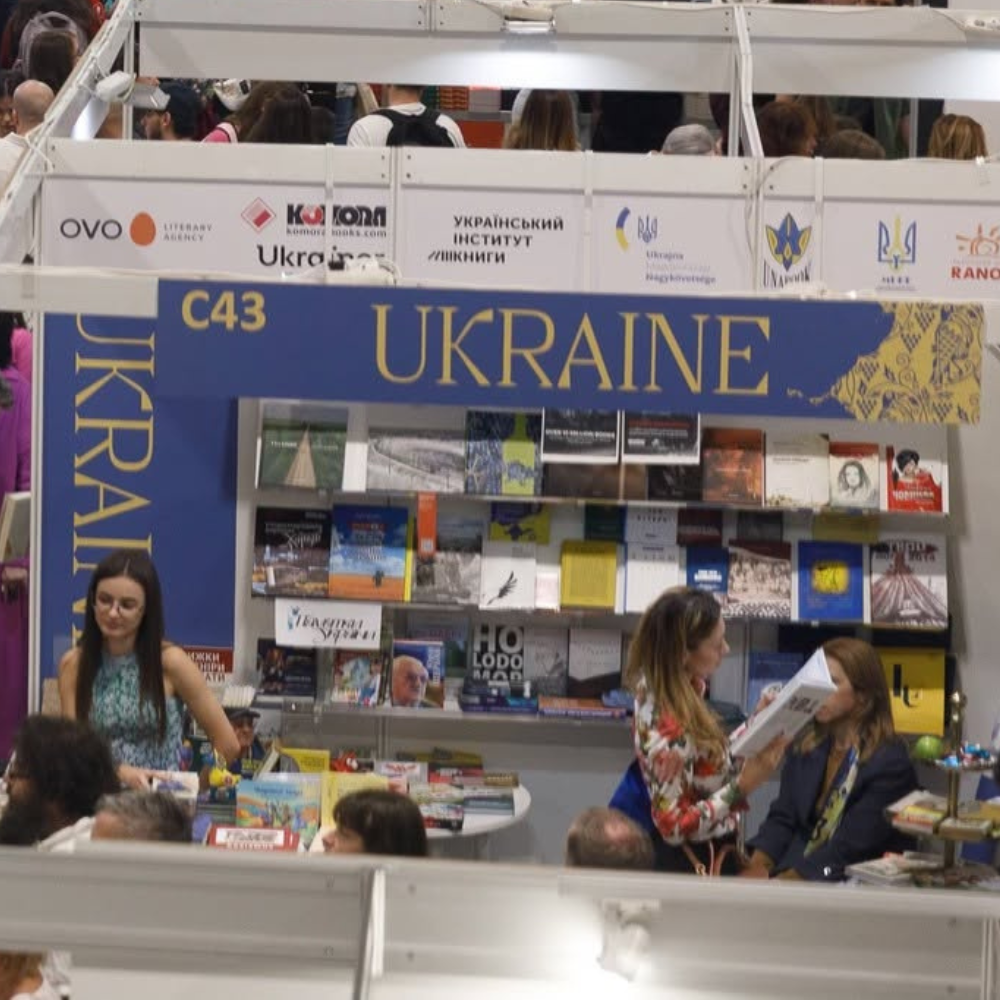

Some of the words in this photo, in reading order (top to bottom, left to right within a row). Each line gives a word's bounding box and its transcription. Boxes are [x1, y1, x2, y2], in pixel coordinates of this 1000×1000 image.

[60, 218, 123, 240] OVO
[163, 224, 213, 232] LITERARY
[453, 214, 564, 231] УКРАЇНСЬКИЙ
[163, 234, 204, 242] AGENCY
[453, 233, 533, 248] ІНСТИТУТ
[181, 290, 267, 333] C43
[371, 302, 771, 397] UKRAINE
[473, 626, 524, 654] HO
[472, 653, 523, 669] LODO
